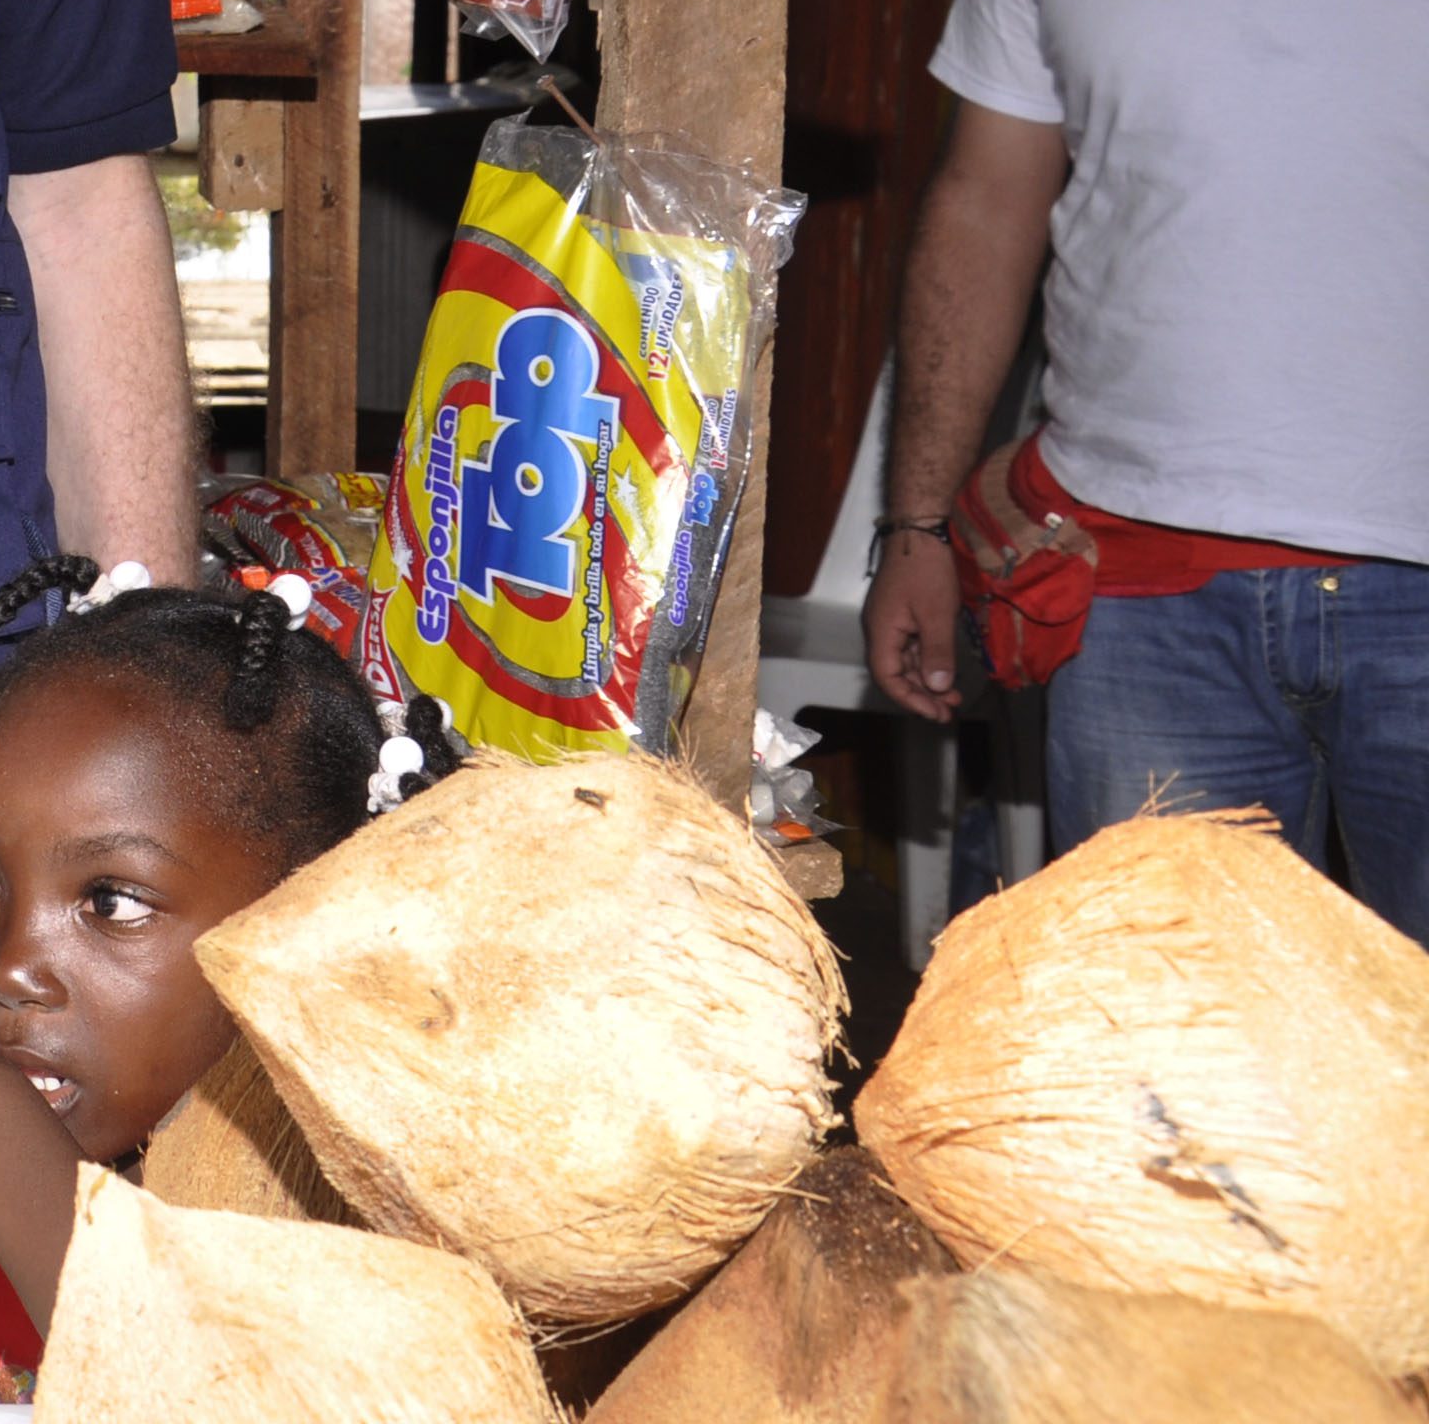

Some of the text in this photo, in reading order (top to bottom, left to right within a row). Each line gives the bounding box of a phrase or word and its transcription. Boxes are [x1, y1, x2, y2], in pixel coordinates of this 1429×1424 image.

[639, 286, 660, 359] CONTENIDO
[647, 350, 671, 381] 12
[594, 420, 611, 472] hogar
[593, 494, 605, 517] en
[595, 473, 607, 493] su
[415, 405, 461, 646] Esponjilla
[589, 519, 604, 560] todo
[585, 561, 602, 607] brilla
[668, 531, 693, 626] Esponjilla
[366, 597, 395, 695] DERSA
[583, 623, 601, 684] Limpia
